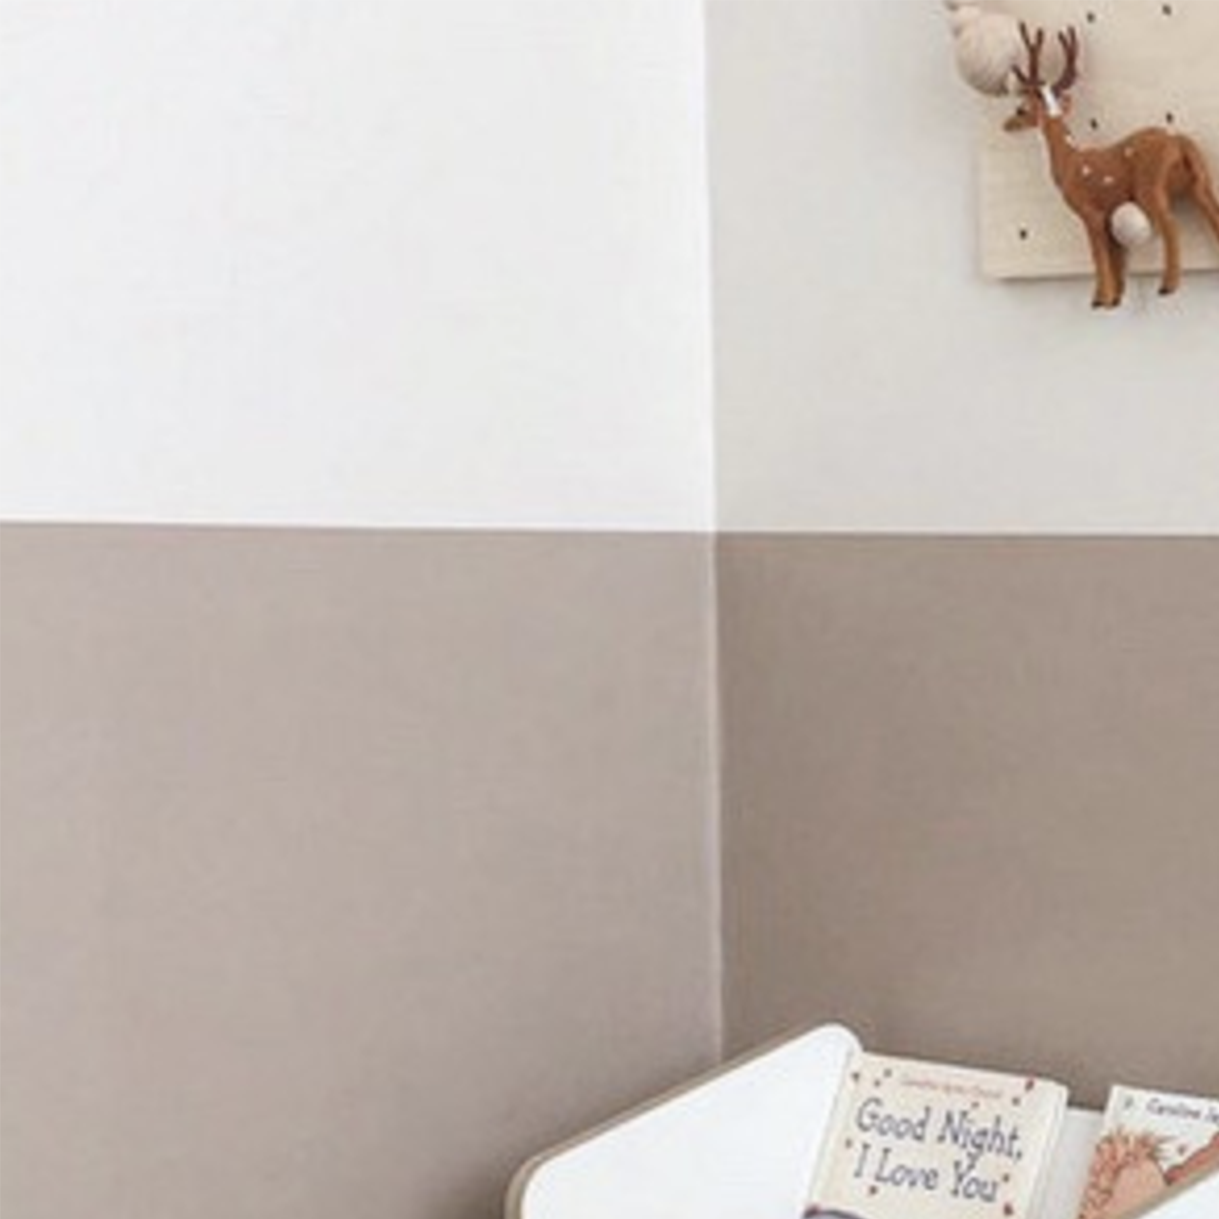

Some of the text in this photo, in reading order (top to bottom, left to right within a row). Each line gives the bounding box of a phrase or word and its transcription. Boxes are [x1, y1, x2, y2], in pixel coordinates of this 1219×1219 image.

[856, 1096, 1023, 1163] Good Night,
[854, 1142, 998, 1203] I Love You
